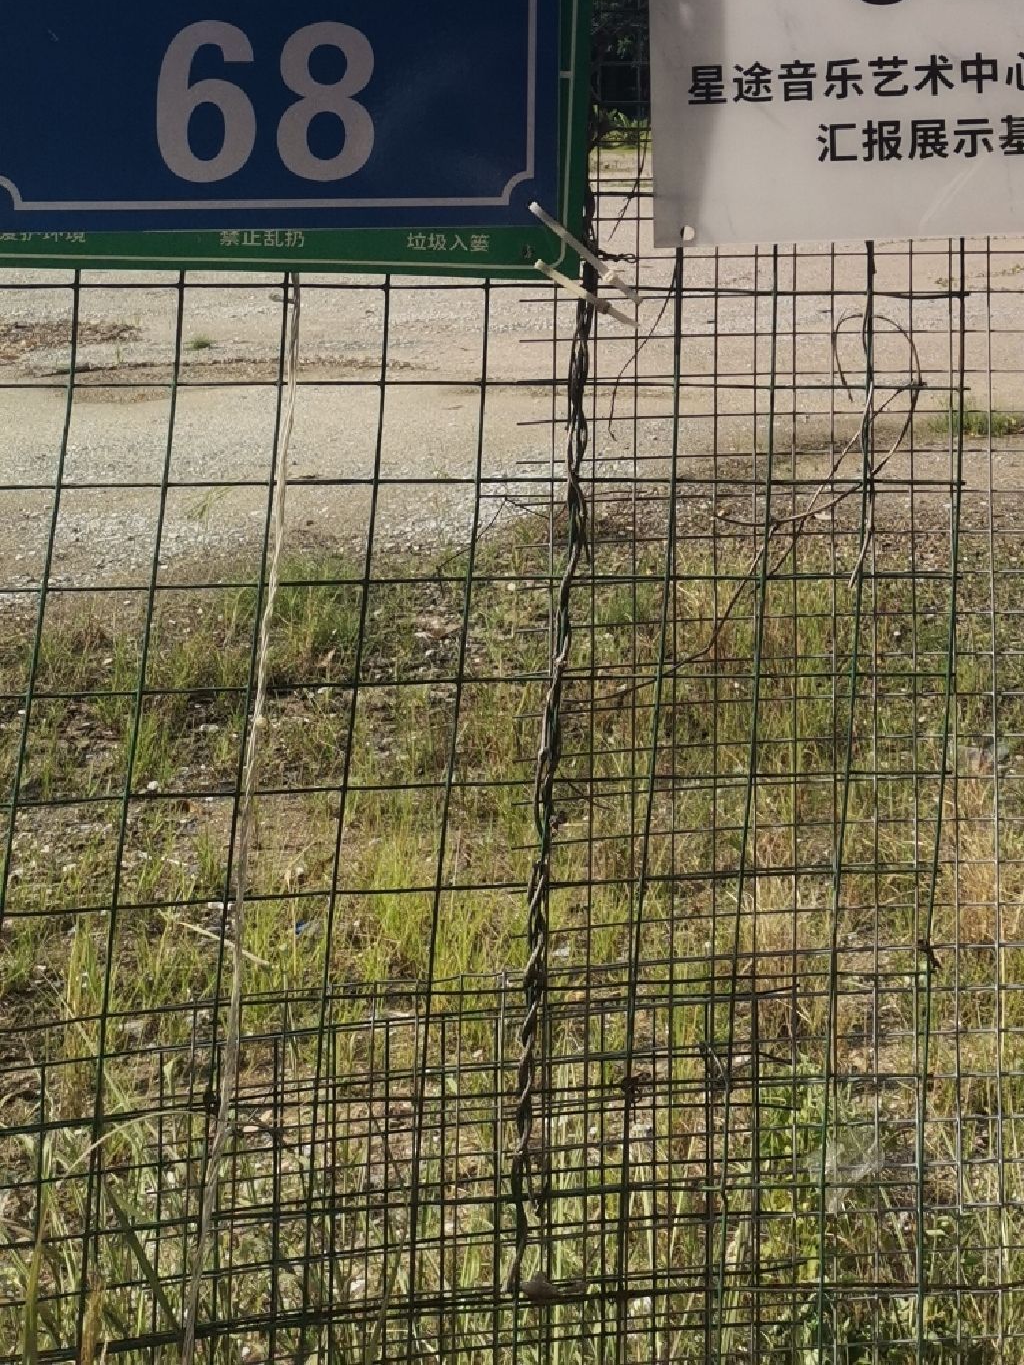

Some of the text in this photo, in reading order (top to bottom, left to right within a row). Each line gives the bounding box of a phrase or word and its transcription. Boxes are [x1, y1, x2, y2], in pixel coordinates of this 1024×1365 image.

[156, 19, 375, 183] 68
[219, 229, 305, 248] 禁止乱扔
[406, 231, 491, 252] 垃圾入篓
